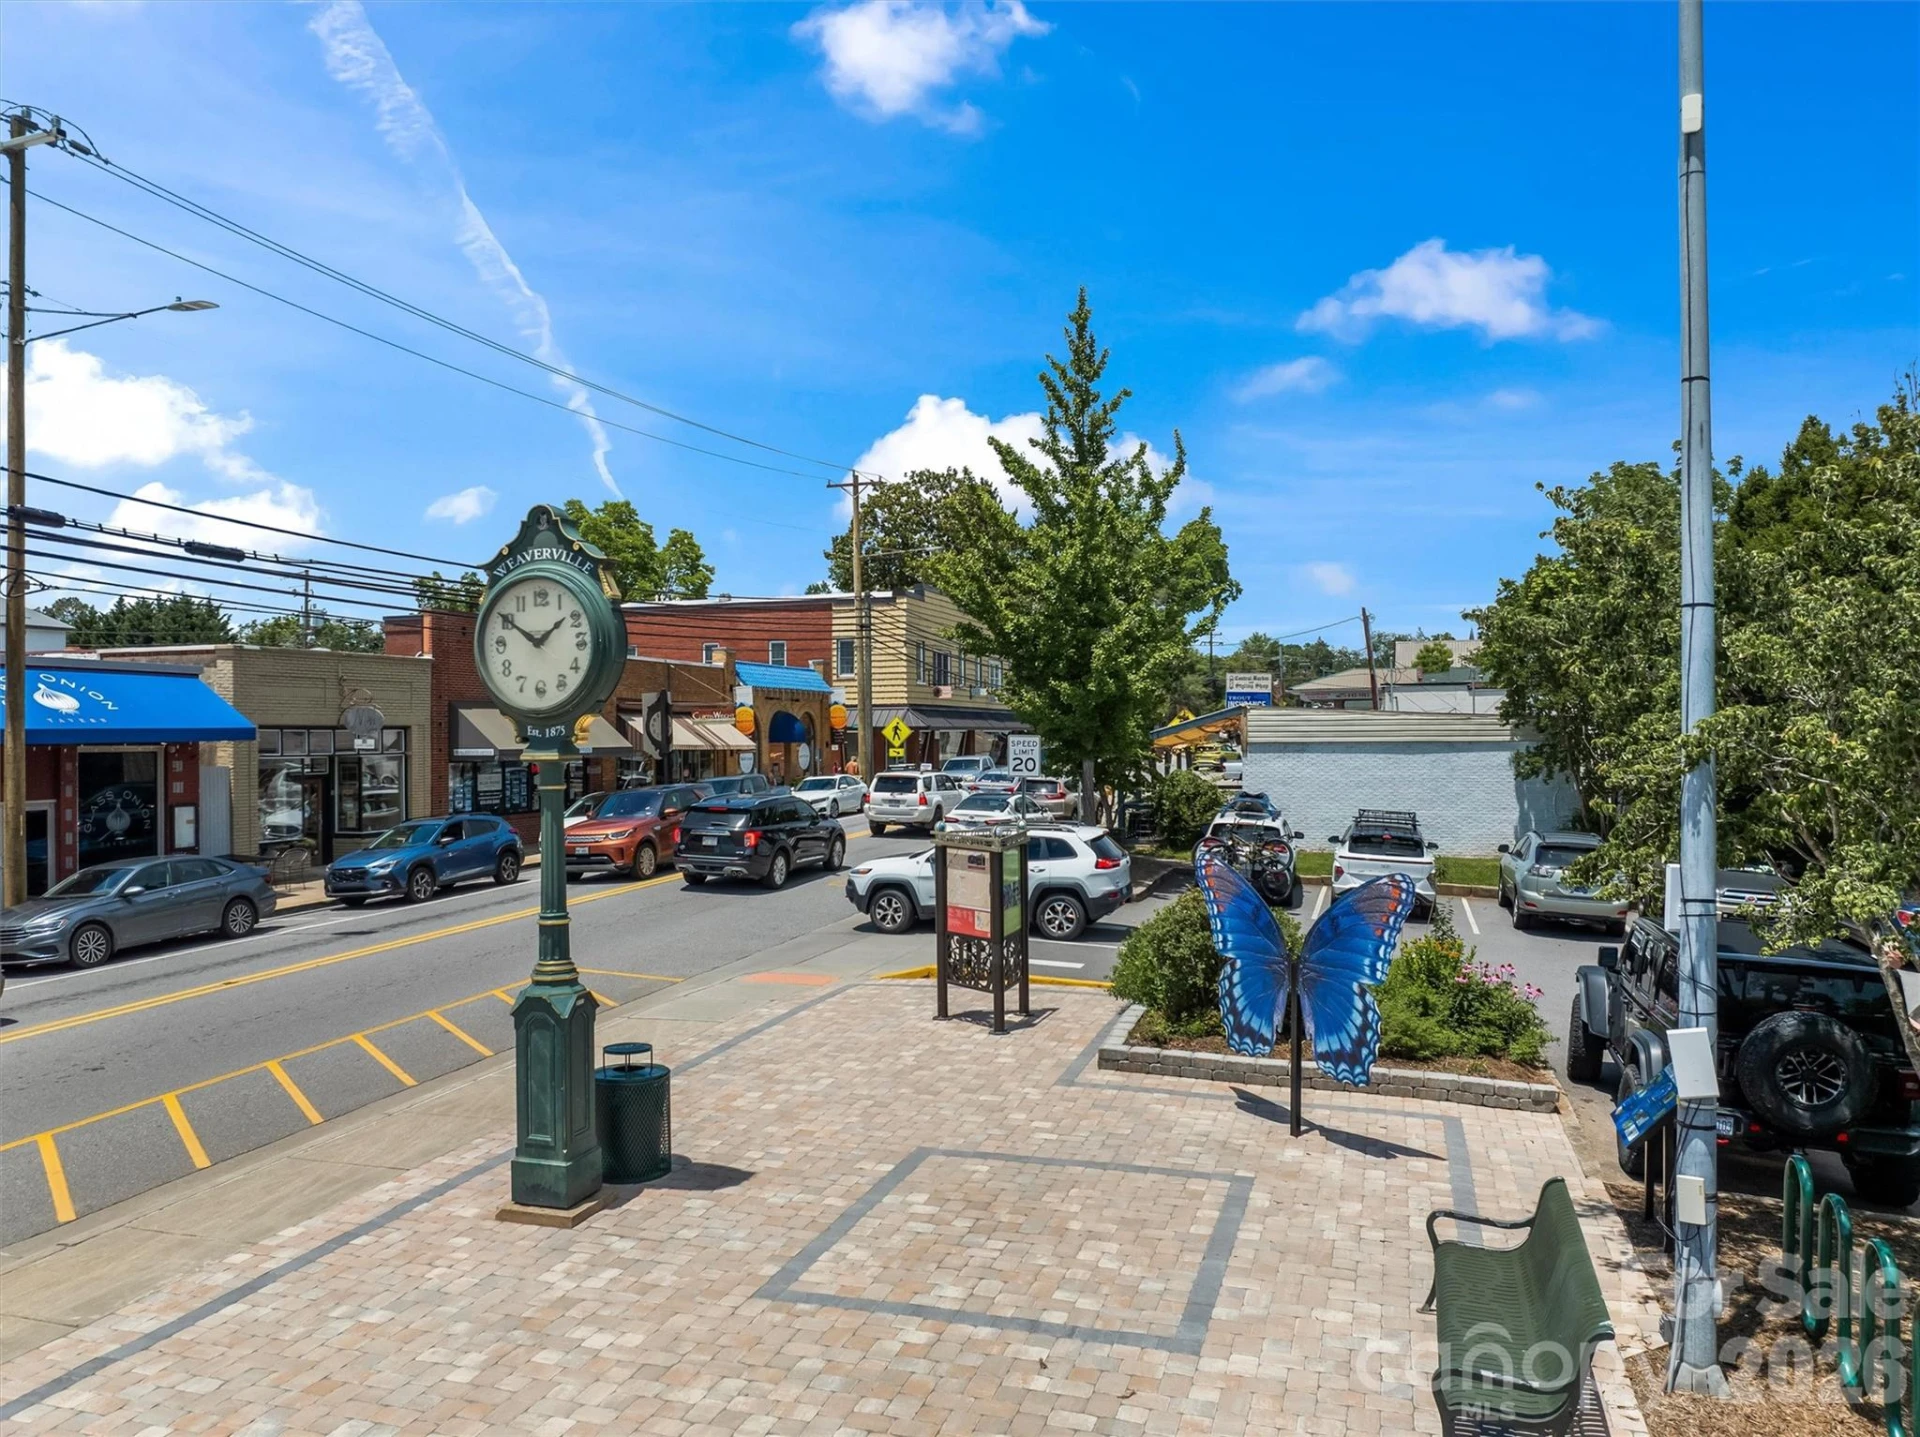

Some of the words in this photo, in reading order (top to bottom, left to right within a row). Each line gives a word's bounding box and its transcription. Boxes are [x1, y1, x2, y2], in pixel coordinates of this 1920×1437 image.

[493, 548, 594, 577] WEAVERVILLE
[515, 595, 526, 613] 11
[534, 589, 550, 607] 12
[570, 610, 582, 628] 2
[495, 635, 507, 655] 9
[575, 632, 588, 651] 3
[502, 659, 512, 677] 8
[570, 657, 581, 674] 4
[39, 673, 119, 710] ONION
[515, 675, 528, 693] 7
[535, 680, 547, 698] 6
[556, 674, 567, 692] 5
[545, 725, 566, 738] 1875
[1011, 740, 1038, 748] SPEED
[1012, 757, 1036, 772] 20
[83, 791, 115, 833] GLASS
[123, 790, 152, 829] ONION
